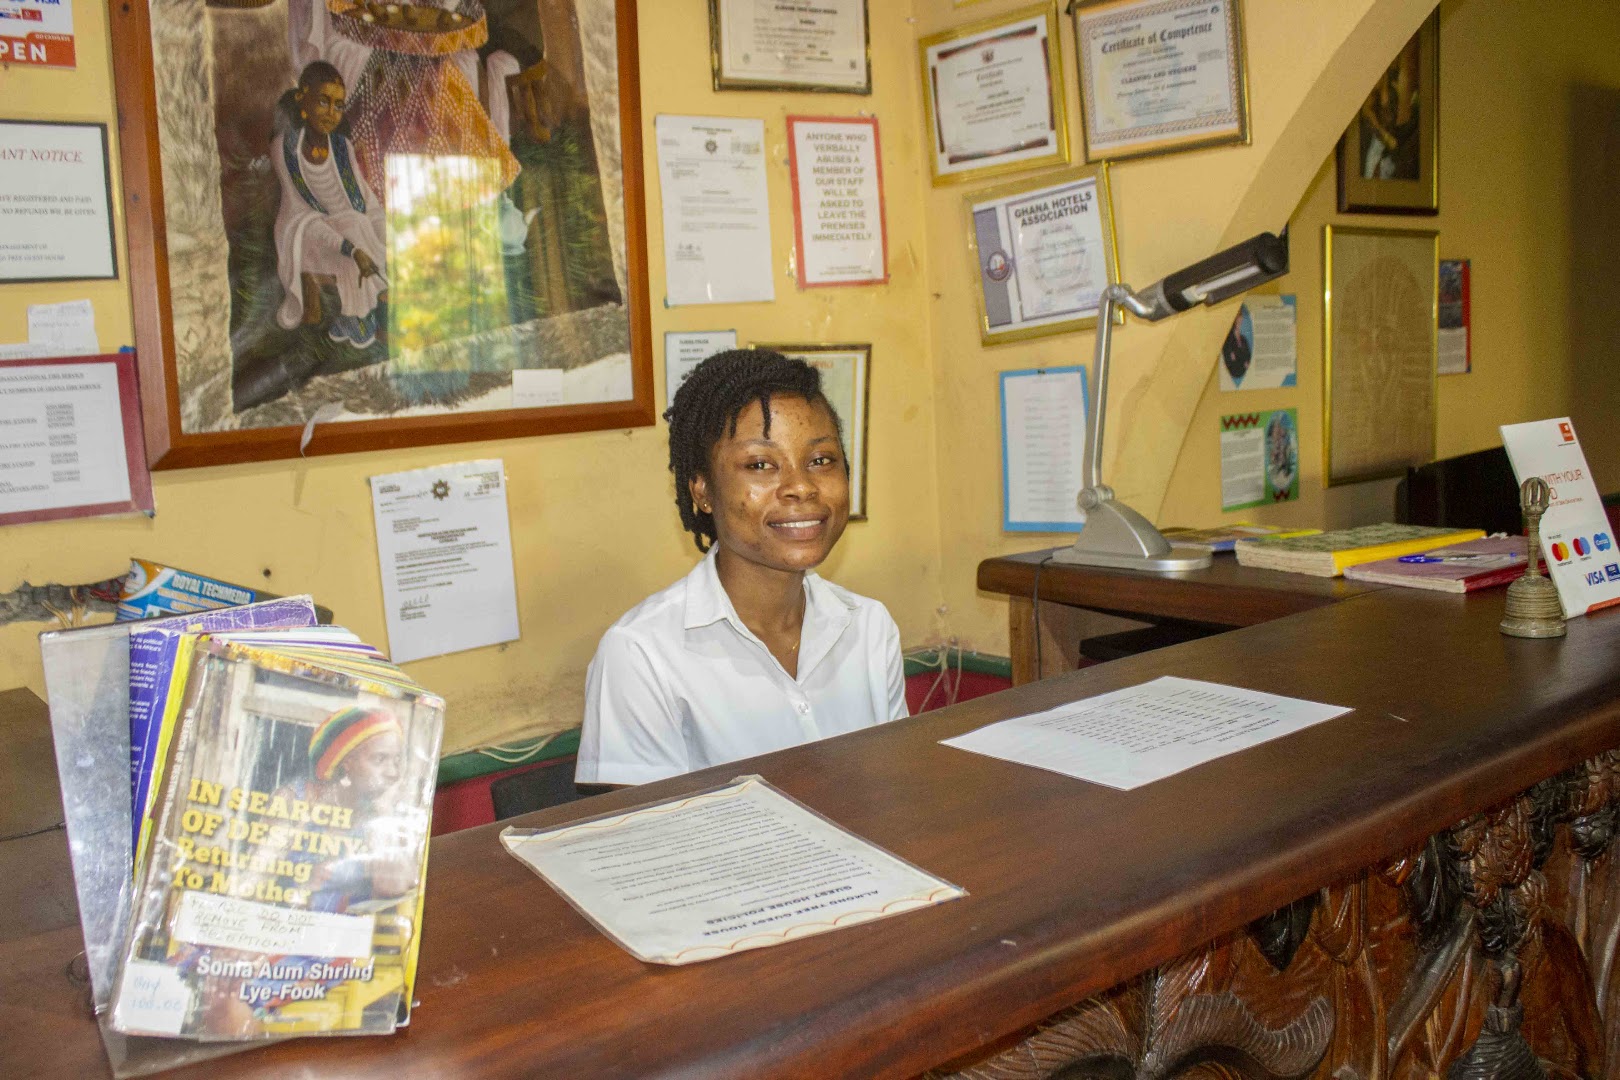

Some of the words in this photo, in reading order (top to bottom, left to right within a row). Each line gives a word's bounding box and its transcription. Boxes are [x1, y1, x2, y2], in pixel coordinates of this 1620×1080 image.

[1101, 37, 1145, 53] Certificate
[1160, 22, 1213, 42] Competence
[806, 133, 842, 141] ANYONE
[846, 134, 867, 142] WHO
[813, 144, 860, 152] VERBALLY
[30, 149, 84, 163] NOTICE
[816, 155, 851, 164] ABUSES
[854, 155, 860, 163] A
[813, 166, 851, 174] MEMBER
[815, 177, 834, 185] OUR
[837, 177, 864, 185] STAFF
[822, 189, 844, 197] WILL
[820, 200, 850, 208] ASKED
[1014, 204, 1050, 219] GHANA
[1052, 191, 1093, 208] HOTELS
[818, 210, 847, 219] LEAVE
[849, 210, 866, 218] THE
[1021, 203, 1089, 227] ASSOCIATION
[820, 221, 866, 230] PREMISES
[1561, 469, 1584, 482] YOUR
[172, 574, 200, 594] ROYAL
[1584, 570, 1606, 586] VISA
[188, 778, 223, 806] IN
[227, 787, 353, 829] SEARCH
[181, 808, 223, 836] OF
[175, 837, 314, 883] Returning
[173, 865, 204, 889] To
[209, 872, 313, 905] Mother
[815, 885, 852, 898] GUEST
[769, 895, 811, 910] HOUSE
[829, 890, 879, 906] ALMOND
[706, 907, 765, 925] POLICIES
[796, 904, 825, 915] TREE
[752, 913, 792, 925] GUEST
[703, 923, 748, 936] HOUSE
[197, 955, 253, 980] Soma
[258, 961, 303, 980] Aum
[308, 961, 374, 982] Shring
[238, 981, 326, 1002] Lye-Fook
